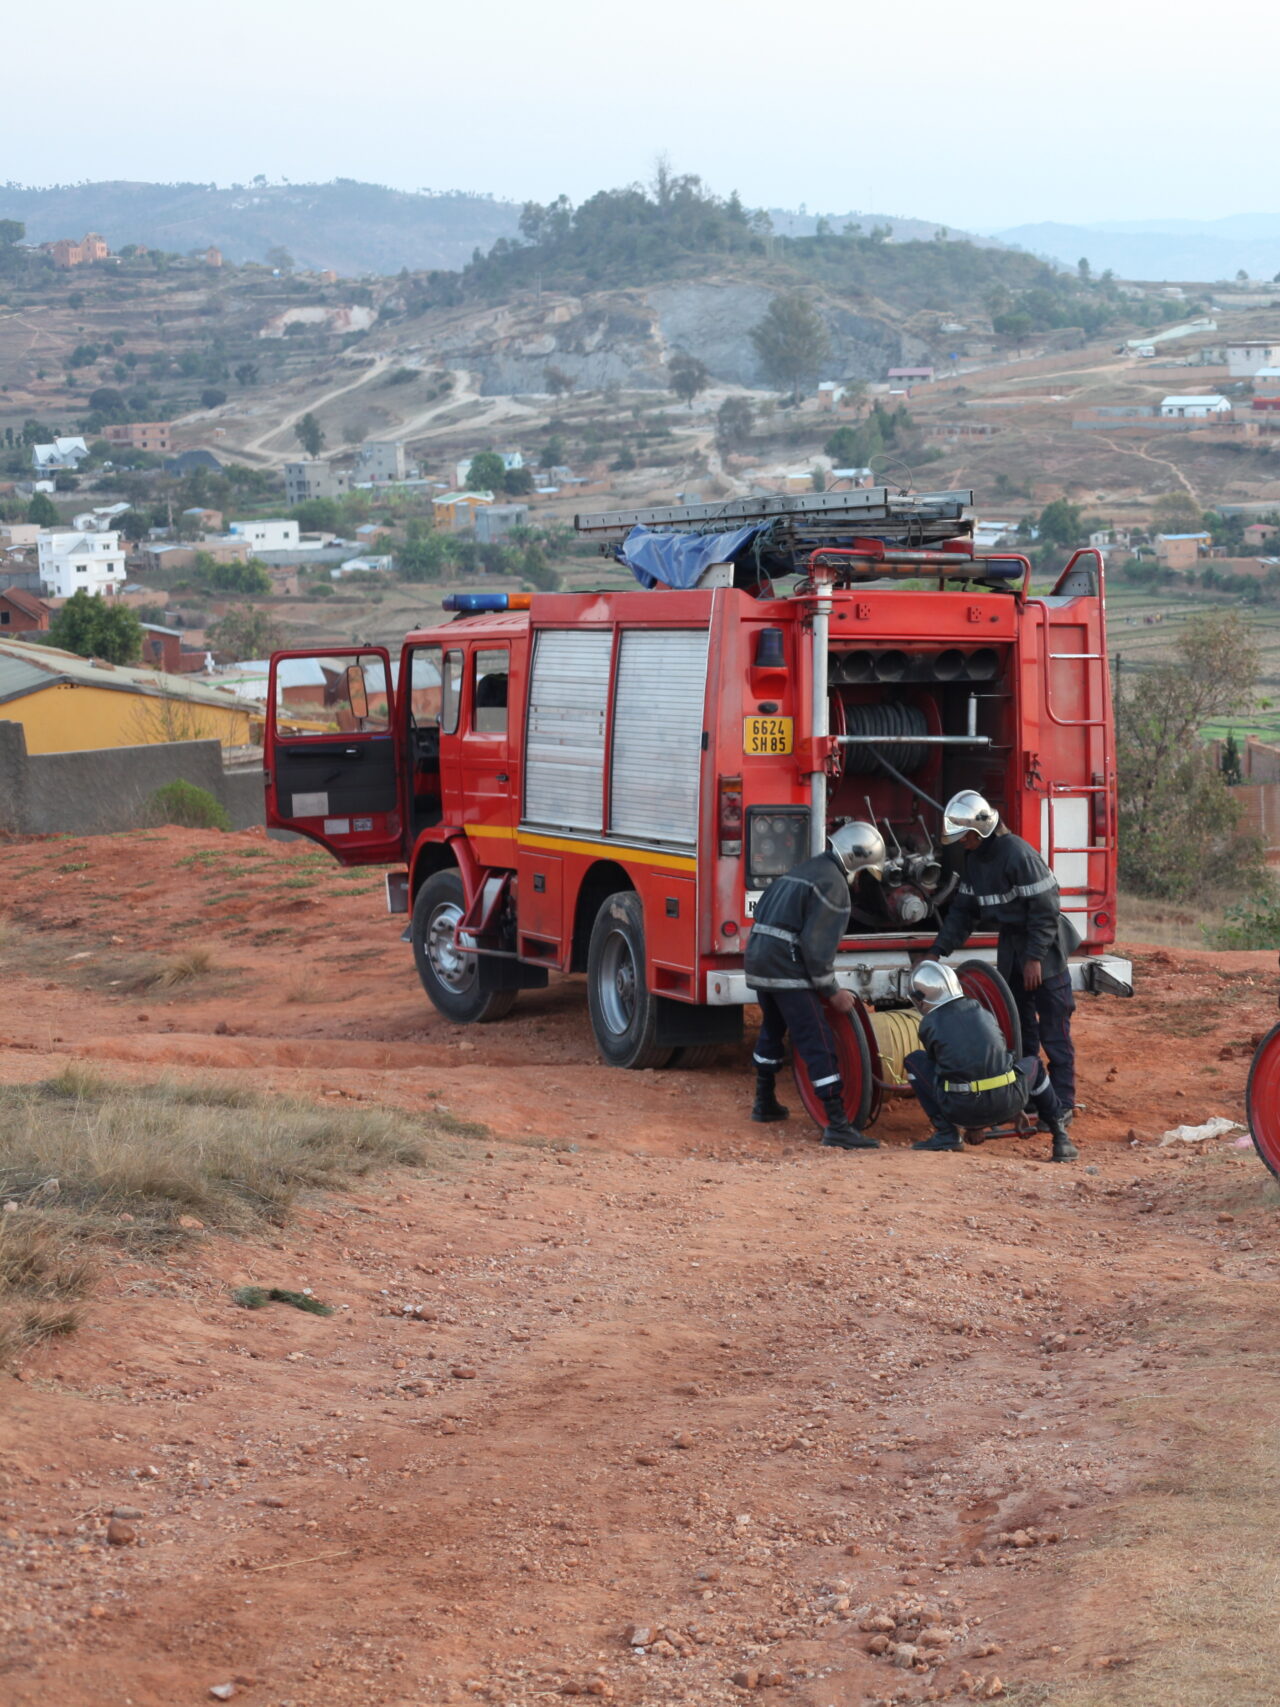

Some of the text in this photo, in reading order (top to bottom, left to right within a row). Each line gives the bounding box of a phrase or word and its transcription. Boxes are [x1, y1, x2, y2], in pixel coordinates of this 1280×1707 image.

[753, 720, 784, 735] 6624
[752, 737, 786, 752] SH 85
